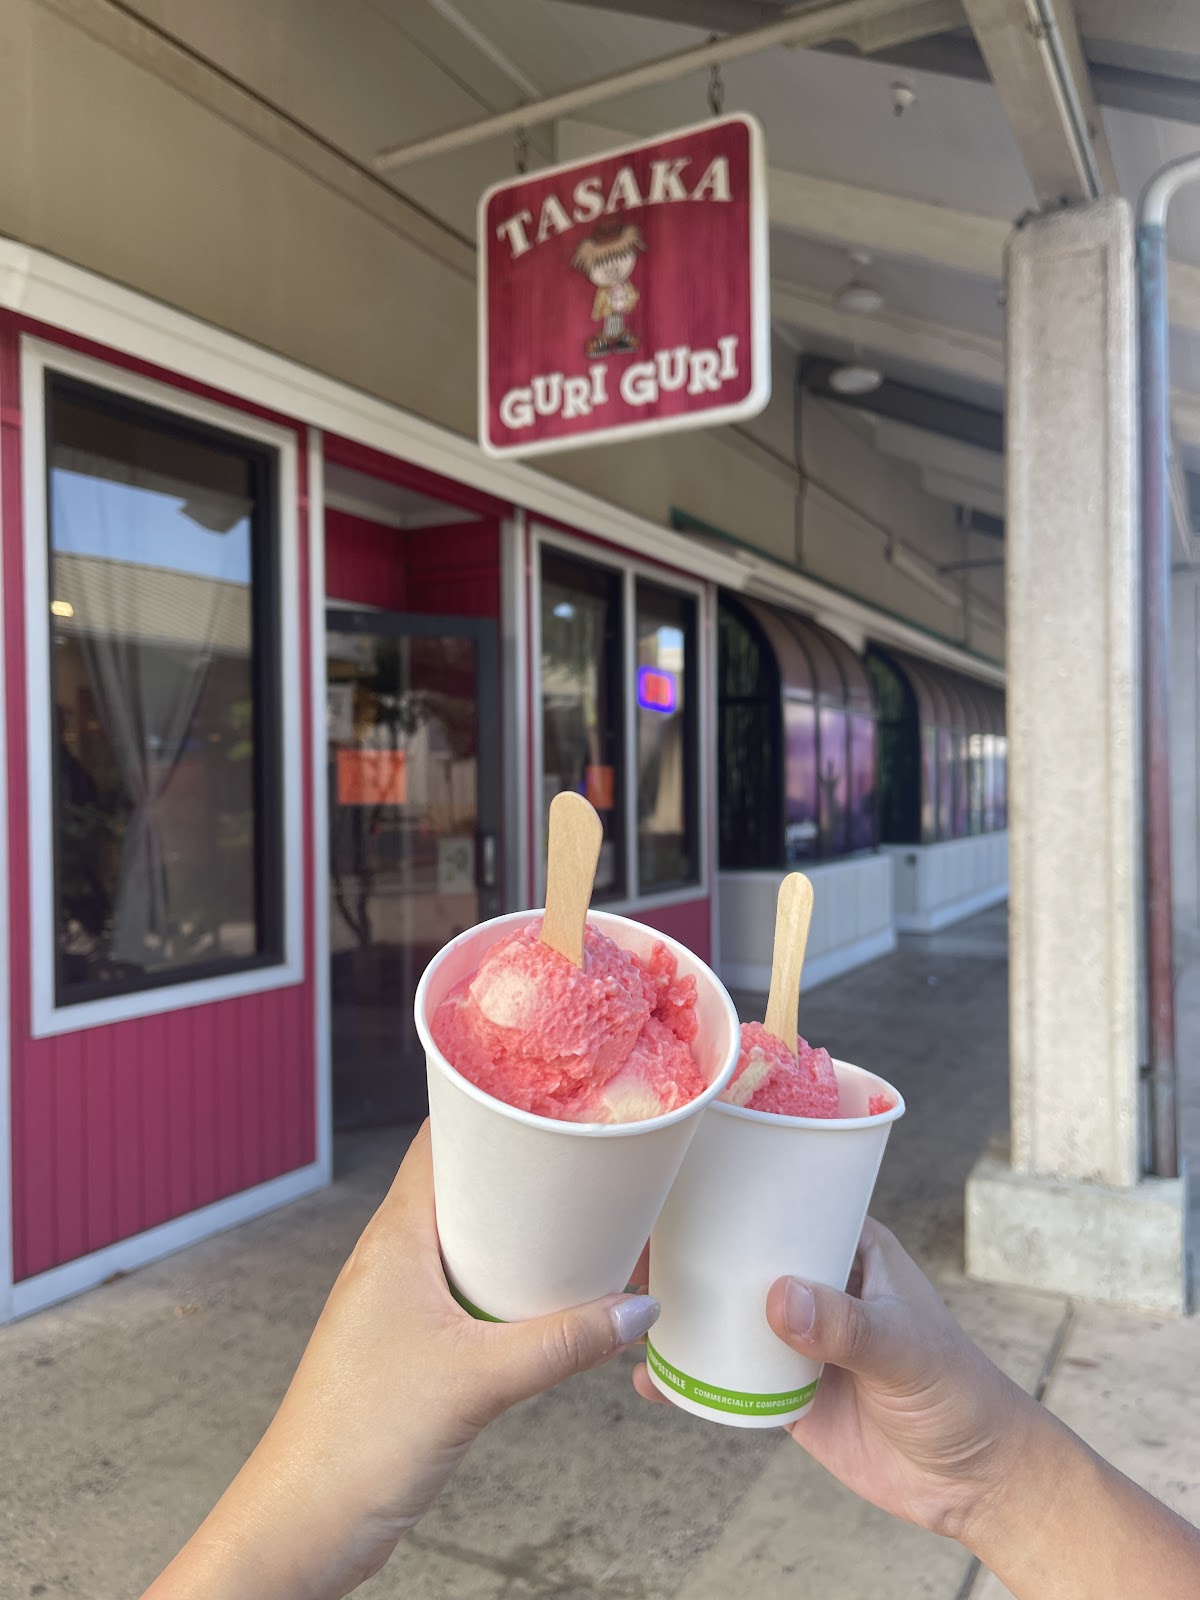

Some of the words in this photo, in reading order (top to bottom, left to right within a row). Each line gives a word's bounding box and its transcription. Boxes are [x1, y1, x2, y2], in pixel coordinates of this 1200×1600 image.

[496, 155, 734, 260] TASAKA
[499, 362, 609, 430] GURI
[620, 334, 740, 407] GURI
[693, 1386, 754, 1409] COMMERCIALLY
